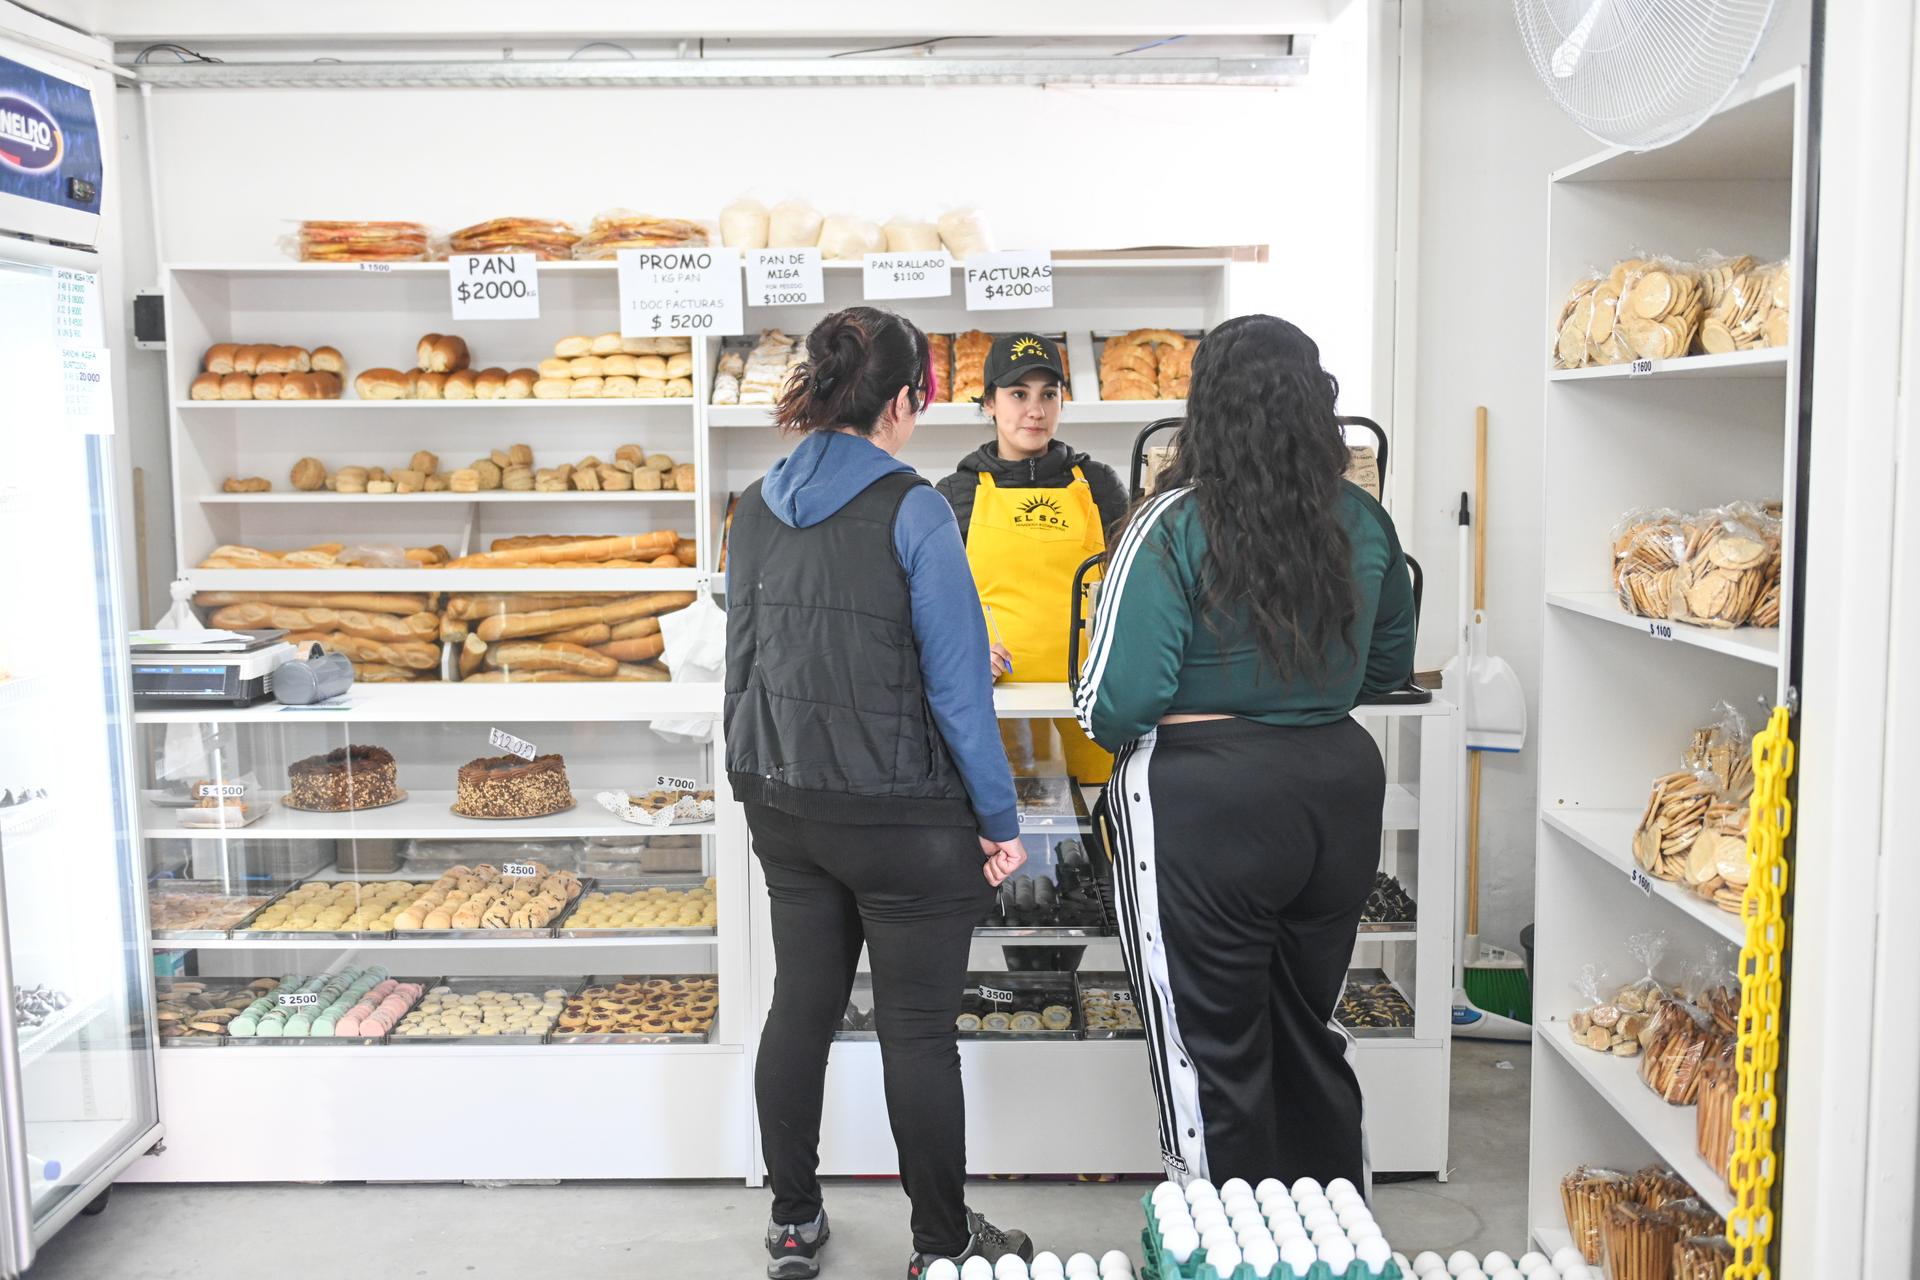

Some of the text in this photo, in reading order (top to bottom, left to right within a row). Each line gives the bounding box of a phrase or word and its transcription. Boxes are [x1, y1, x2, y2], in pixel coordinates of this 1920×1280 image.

[0, 109, 51, 147] NELRO
[469, 256, 516, 275] PAN
[640, 254, 712, 270] PROMO
[760, 254, 805, 265] PAN DE
[872, 259, 945, 269] PAN RALLADO
[368, 264, 390, 272] 1500
[768, 269, 800, 279] MIGA
[968, 265, 1053, 283] FACTURAS
[661, 274, 675, 283] KG
[678, 273, 701, 283] PAN
[893, 272, 925, 282] $1100
[457, 280, 526, 304] $2000
[985, 283, 1033, 300] $4200
[640, 300, 663, 310] DOC
[666, 299, 724, 310] FACTURAS
[764, 293, 807, 305] $10000
[651, 314, 713, 331] $ 5200
[1010, 349, 1049, 361] EL SOL
[1014, 514, 1070, 528] EL SOL
[657, 776, 694, 790] $ 7000
[213, 787, 243, 795] 1500
[503, 865, 534, 875] $ 2500
[290, 995, 317, 1004] 2500
[986, 990, 1012, 1000] 3500
[1162, 1153, 1185, 1170] adidas
